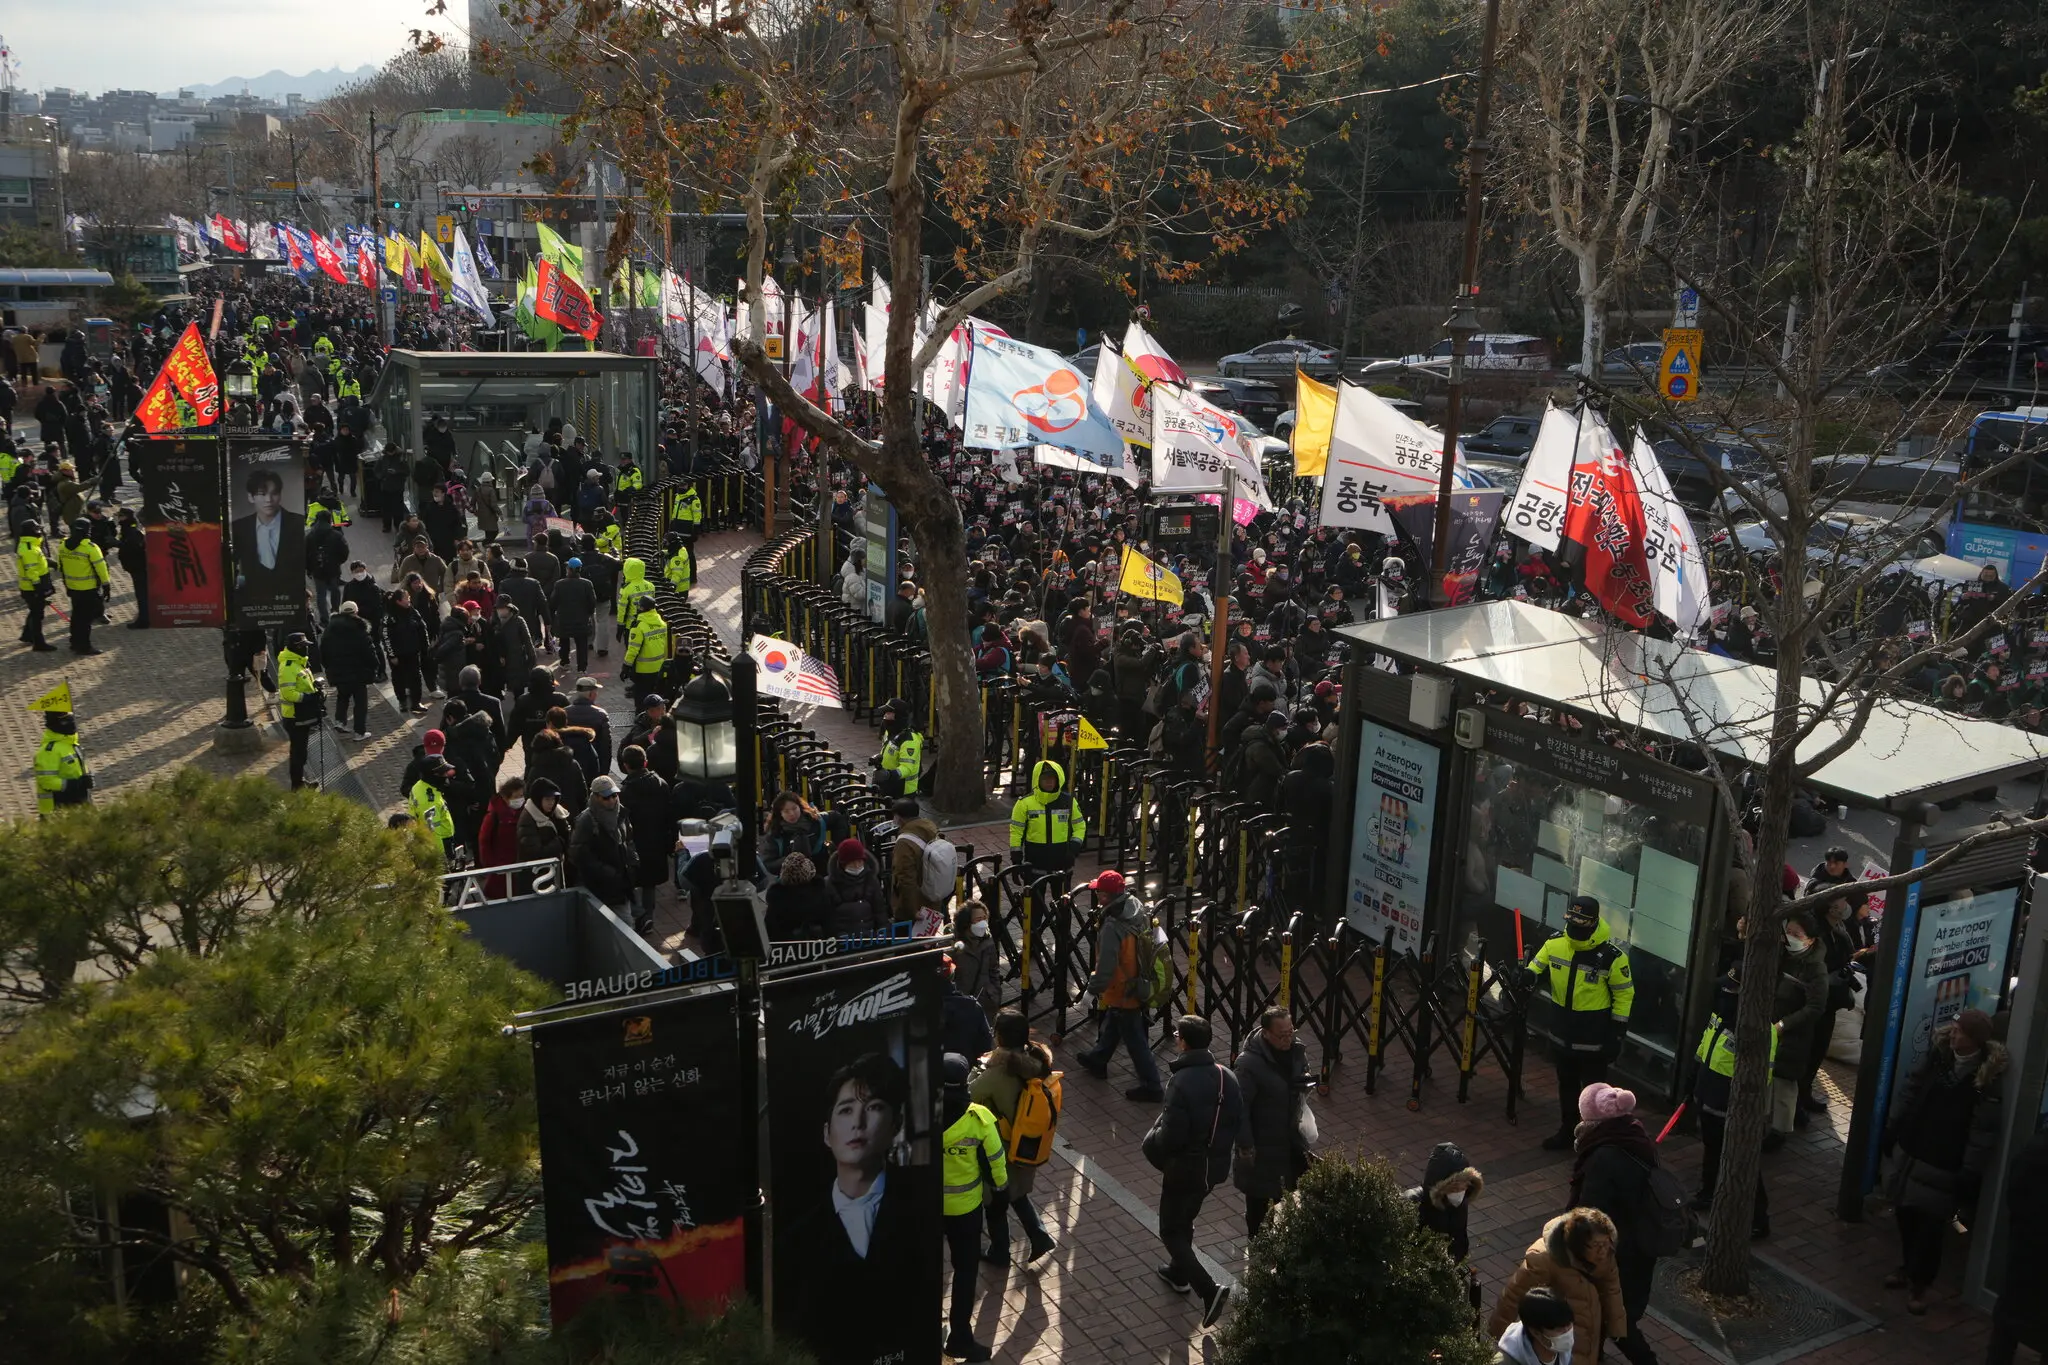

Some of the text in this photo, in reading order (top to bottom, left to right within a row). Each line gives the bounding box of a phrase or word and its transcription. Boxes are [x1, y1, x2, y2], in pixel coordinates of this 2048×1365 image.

[384, 291, 394, 301] P
[998, 341, 1034, 360] 민주노총
[1396, 433, 1424, 449] 민주노총
[1336, 475, 1387, 517] 충북
[1965, 543, 1993, 554] GLPro
[1374, 760, 1422, 784] member stores
[1375, 746, 1423, 775] At zeropay
[1373, 772, 1421, 800] payment OK!
[1934, 918, 1993, 941] At zeropay
[1931, 934, 1990, 956] member stores
[1927, 947, 1988, 975] payment OK!
[603, 1054, 677, 1080] 지금 이 순간
[578, 1067, 702, 1107] 끝나지 않는 신화
